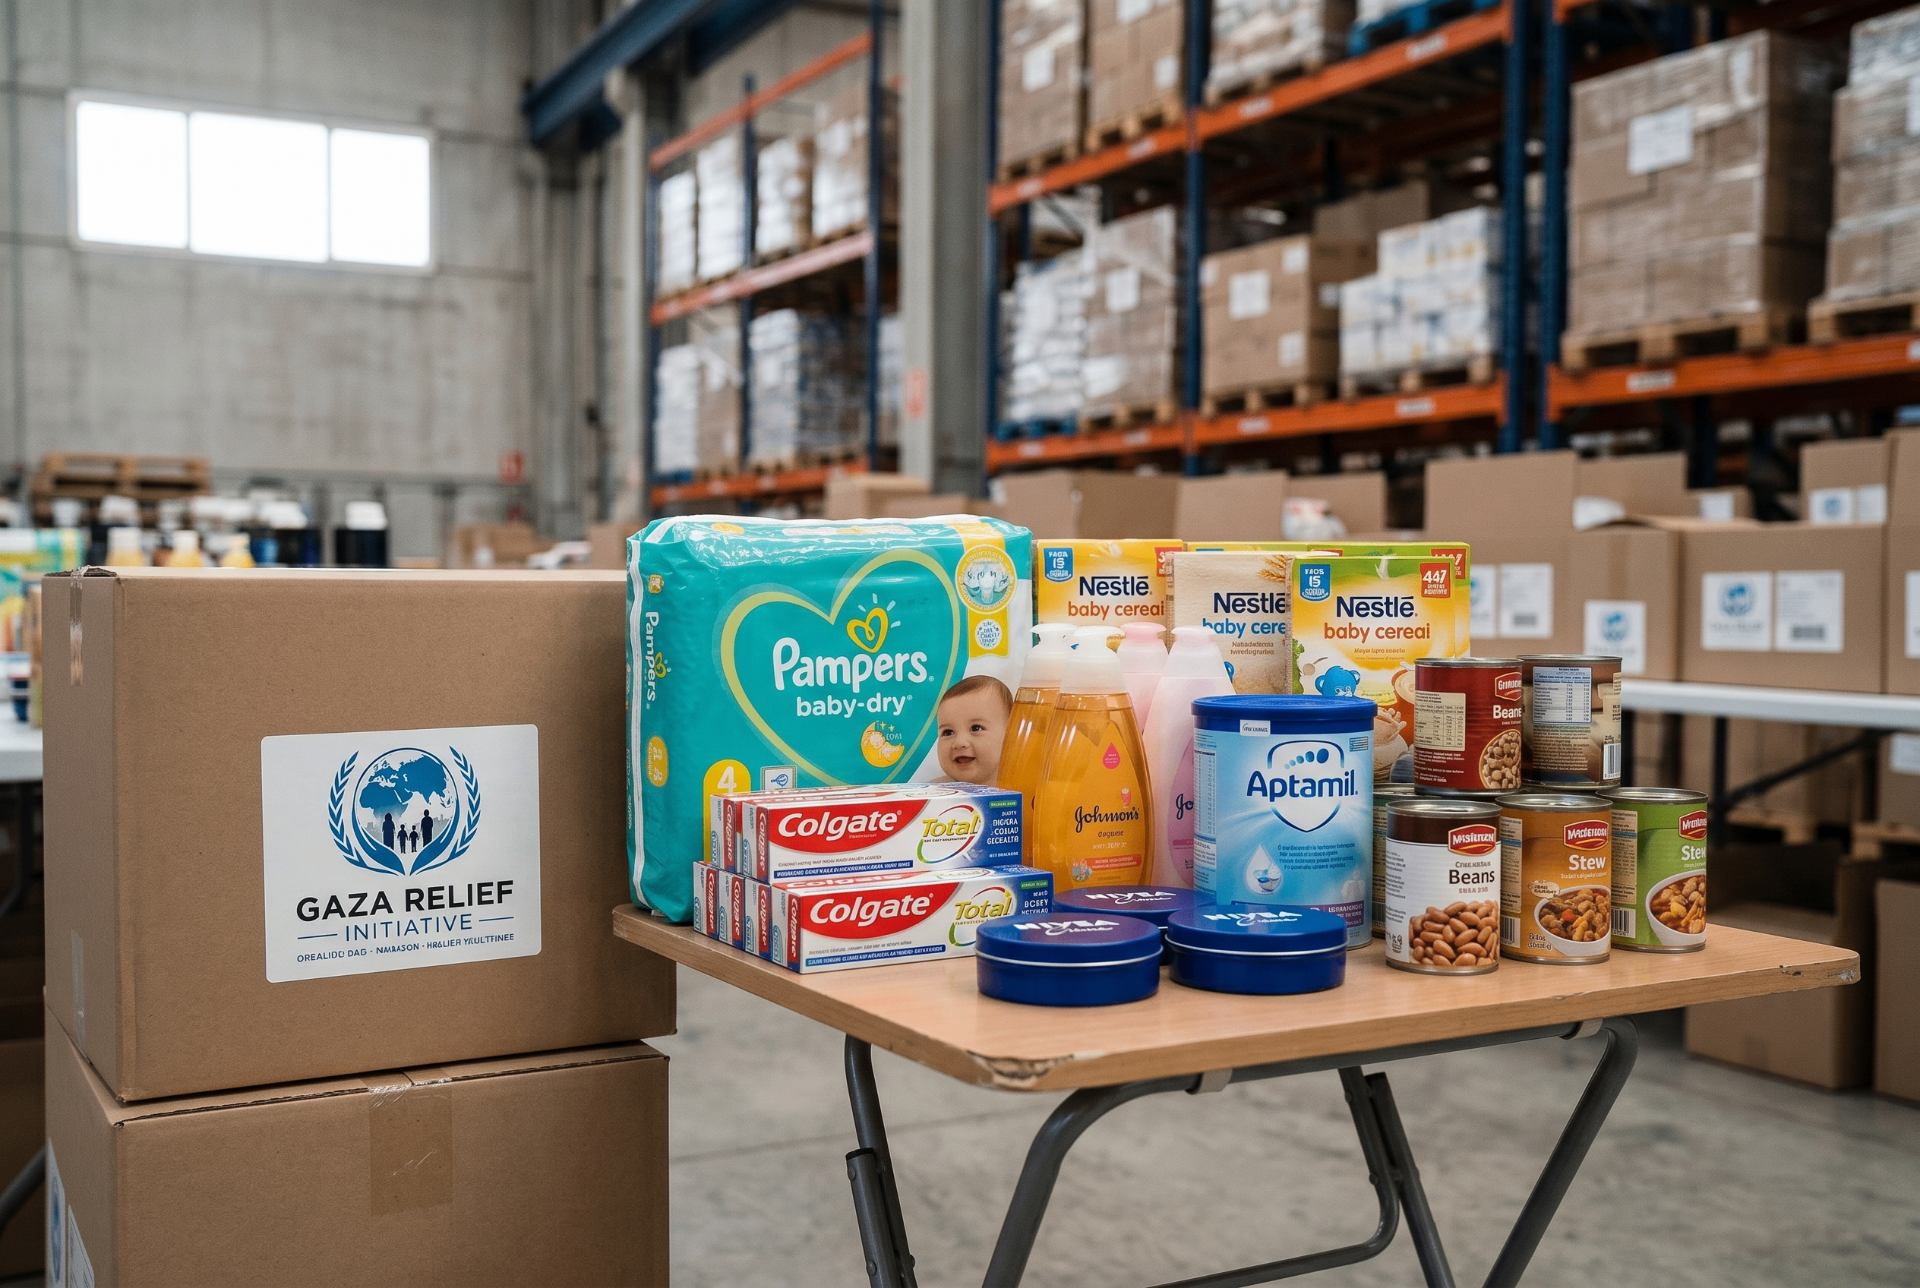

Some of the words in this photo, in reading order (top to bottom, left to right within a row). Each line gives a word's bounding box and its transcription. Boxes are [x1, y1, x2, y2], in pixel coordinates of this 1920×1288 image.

[1079, 575, 1149, 596] Nestlé
[1068, 600, 1110, 621] baby
[1336, 595, 1415, 618] Nestlé
[1202, 617, 1247, 639] baby
[1250, 621, 1286, 635] cere
[1324, 621, 1371, 644] baby
[645, 611, 660, 702] Pampers
[772, 636, 928, 694] Pampers
[796, 692, 906, 719] baby-dry
[717, 765, 737, 794] 4
[1246, 769, 1356, 803] Aptamil
[777, 810, 898, 842] Colgate
[921, 814, 979, 838] Total
[1568, 854, 1607, 871] Stew
[1448, 869, 1495, 885] Beans
[296, 890, 394, 922] GAZA
[404, 879, 514, 912] RELIEF
[810, 894, 930, 927] Colgate
[954, 896, 1013, 920] Total
[345, 913, 473, 942] INITIATIVE
